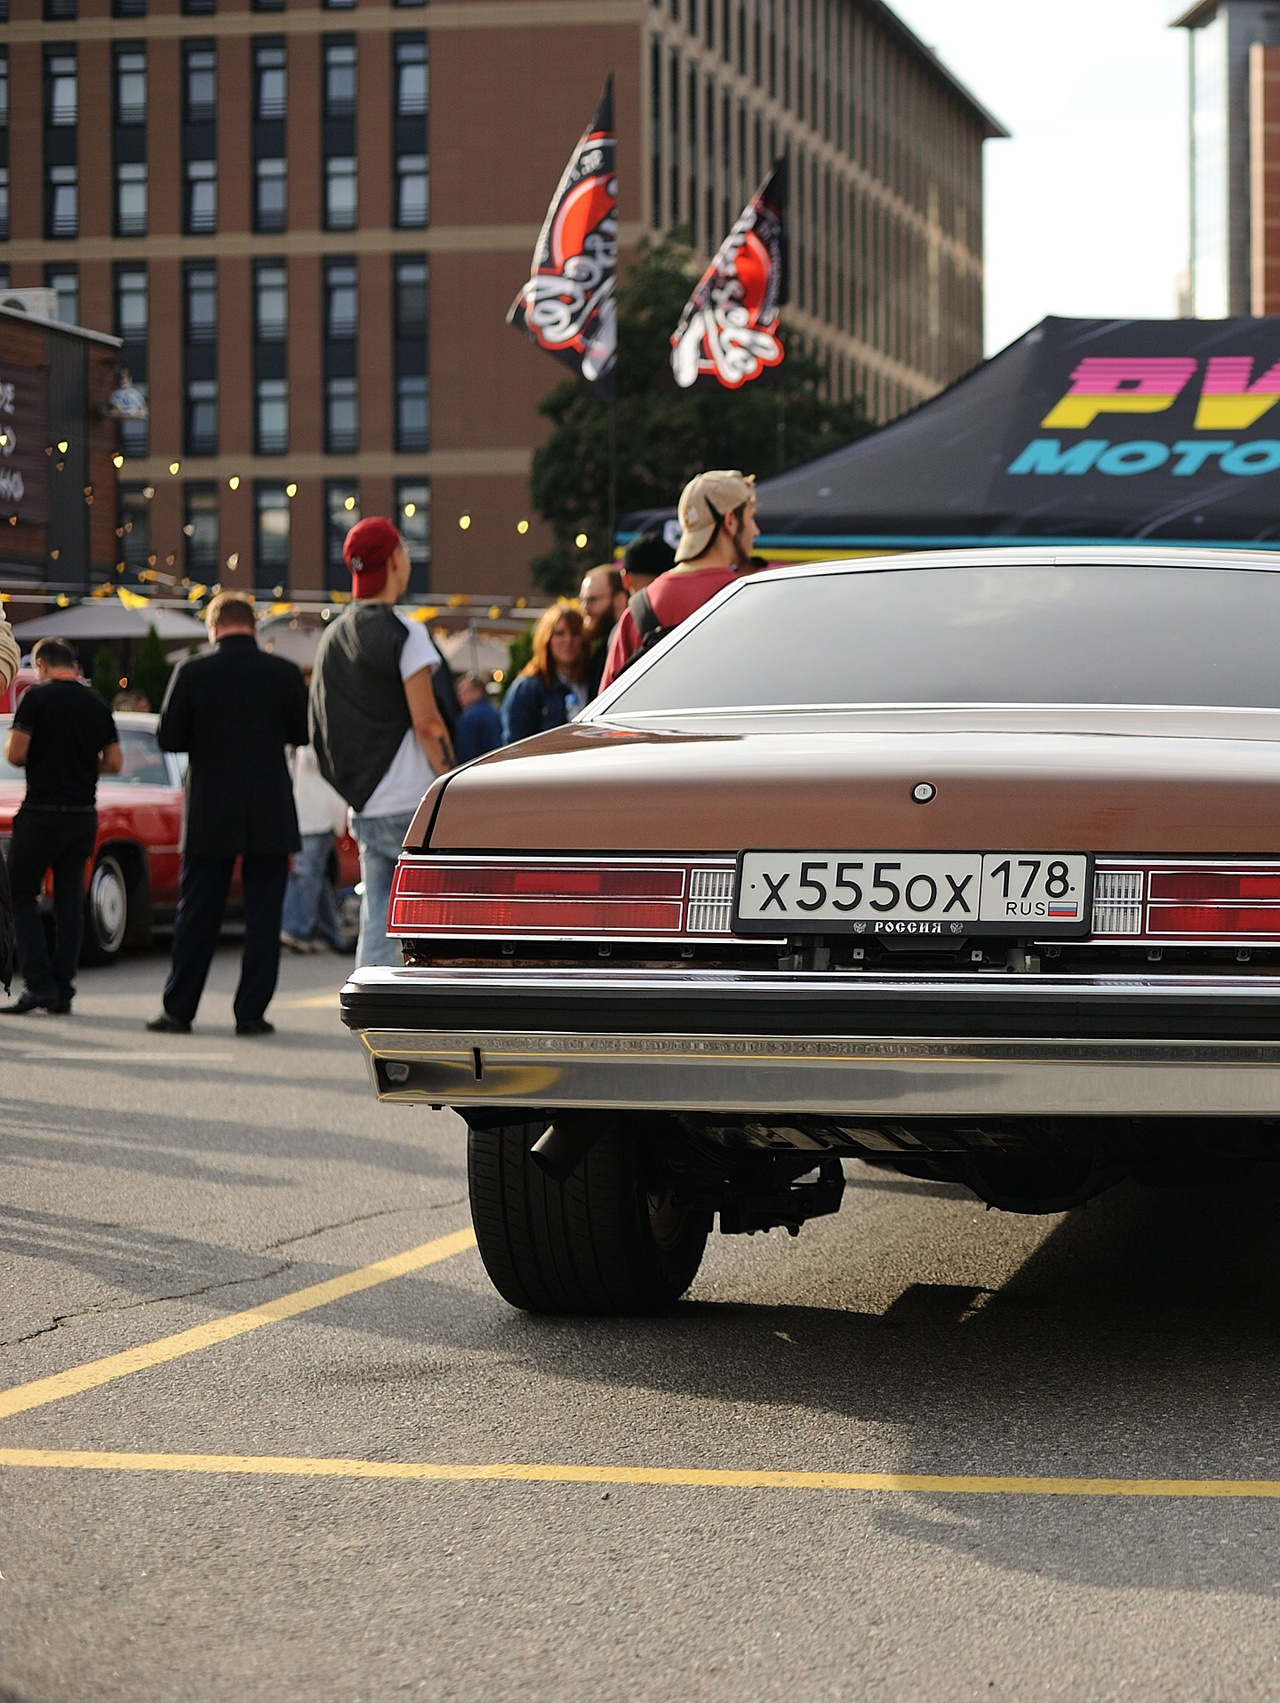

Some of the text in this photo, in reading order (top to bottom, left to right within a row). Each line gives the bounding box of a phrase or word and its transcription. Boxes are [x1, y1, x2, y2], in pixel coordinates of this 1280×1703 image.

[989, 860, 1071, 899] 178
[1004, 902, 1046, 917] RUS
[873, 921, 943, 935] РОССИЯ
